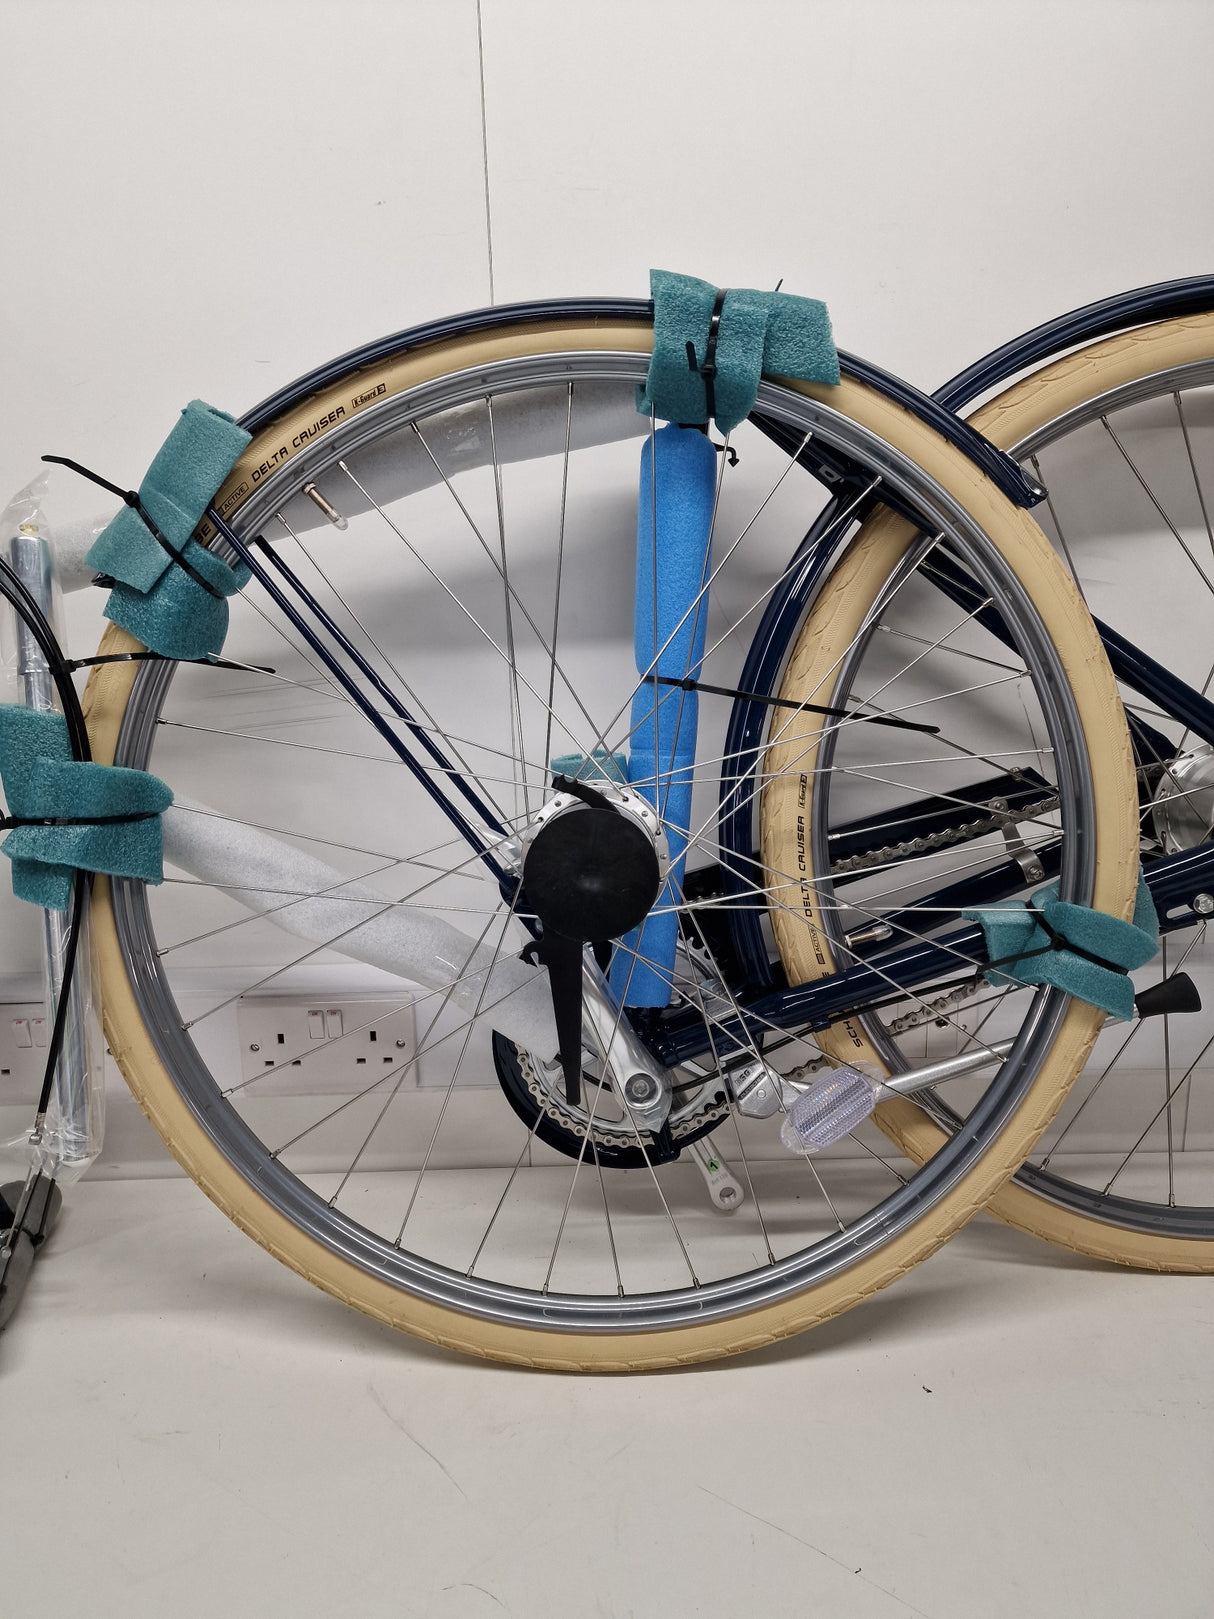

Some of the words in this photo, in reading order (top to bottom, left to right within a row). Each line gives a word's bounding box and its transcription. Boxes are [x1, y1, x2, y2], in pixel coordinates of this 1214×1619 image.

[224, 486, 246, 510] ACTIVE
[251, 446, 289, 482] DELTA
[292, 406, 346, 448] CRUISER
[354, 390, 377, 407] K-Guard
[797, 815, 806, 871] CRUISER
